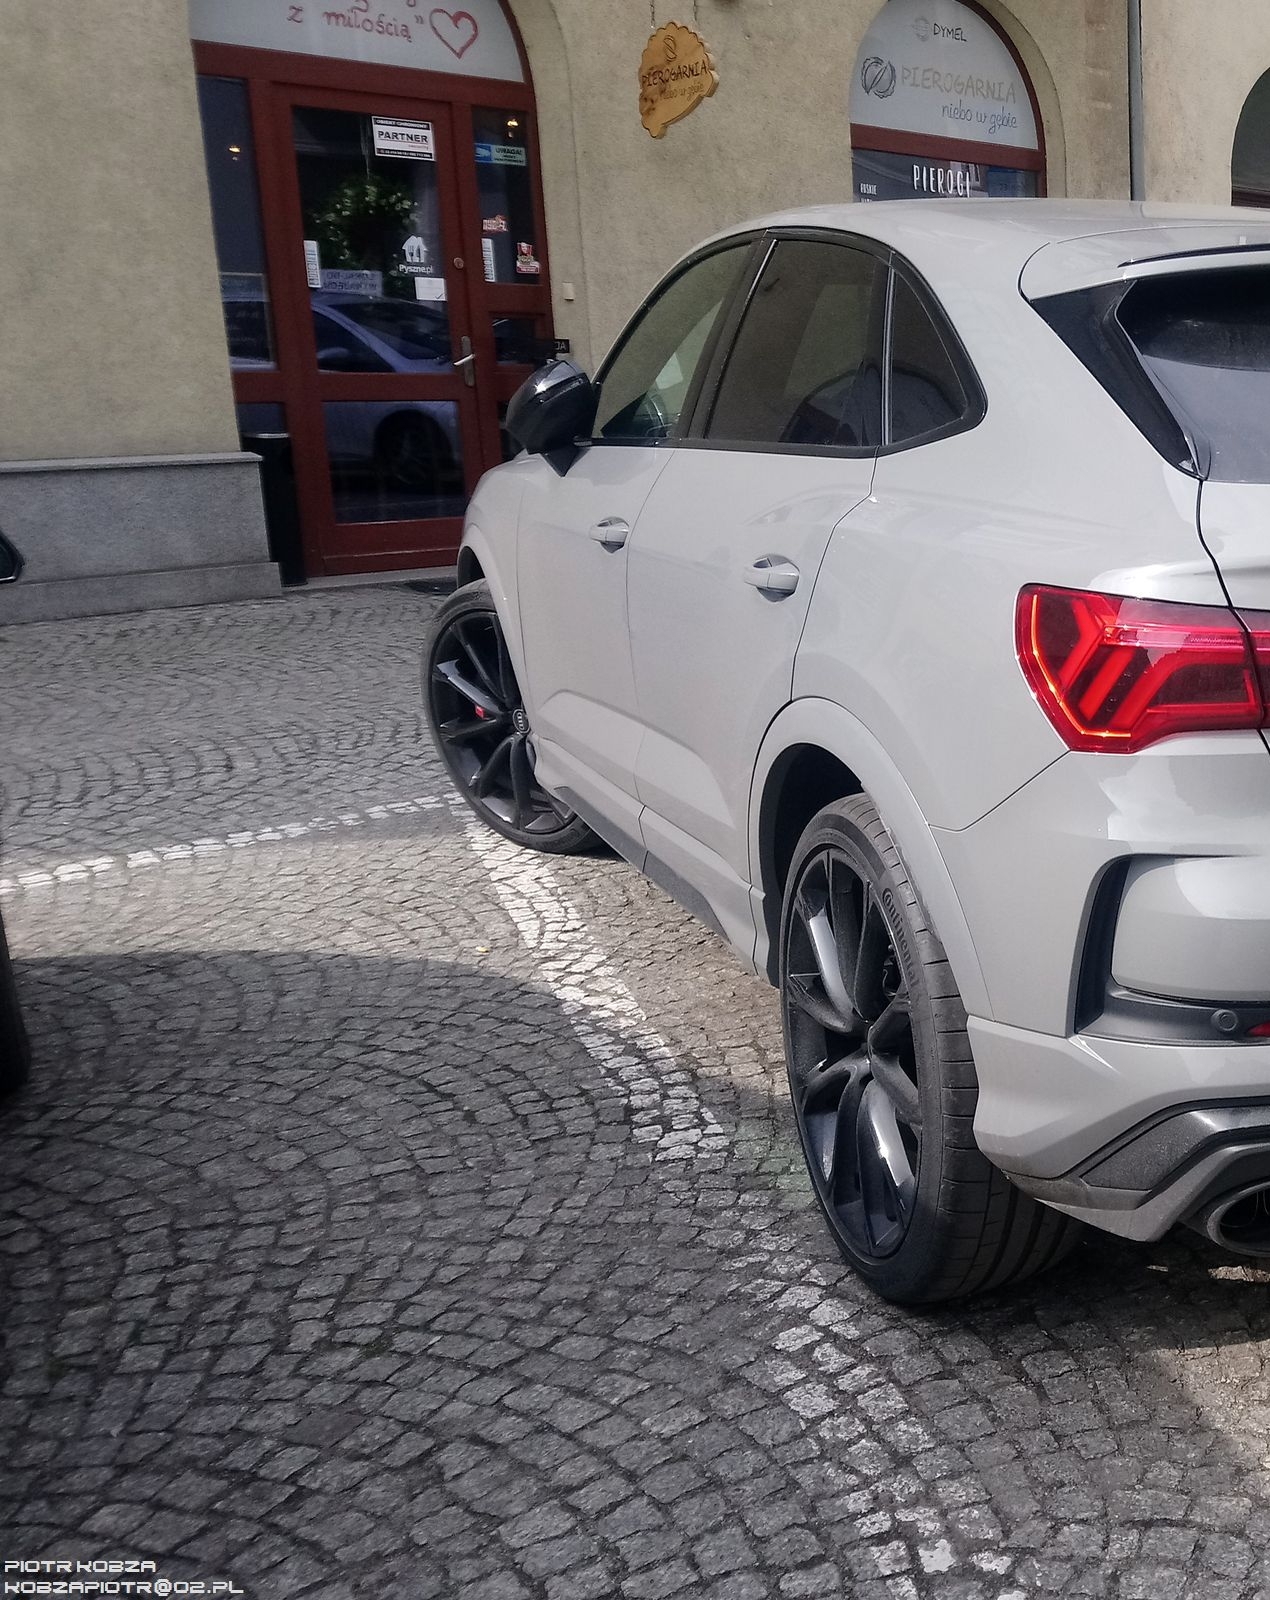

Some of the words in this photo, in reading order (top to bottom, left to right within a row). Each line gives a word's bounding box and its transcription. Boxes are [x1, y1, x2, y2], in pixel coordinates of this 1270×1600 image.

[286, 5, 304, 23] z
[933, 22, 967, 42] DYMEL
[641, 59, 708, 87] PIEROGARNIA
[901, 65, 1016, 104] PIEROGARNIA
[942, 100, 973, 123] niebo
[975, 111, 987, 124] w
[377, 130, 429, 143] PARTNER
[913, 164, 970, 198] PIEROGI
[399, 263, 433, 275] Pyszne.pl
